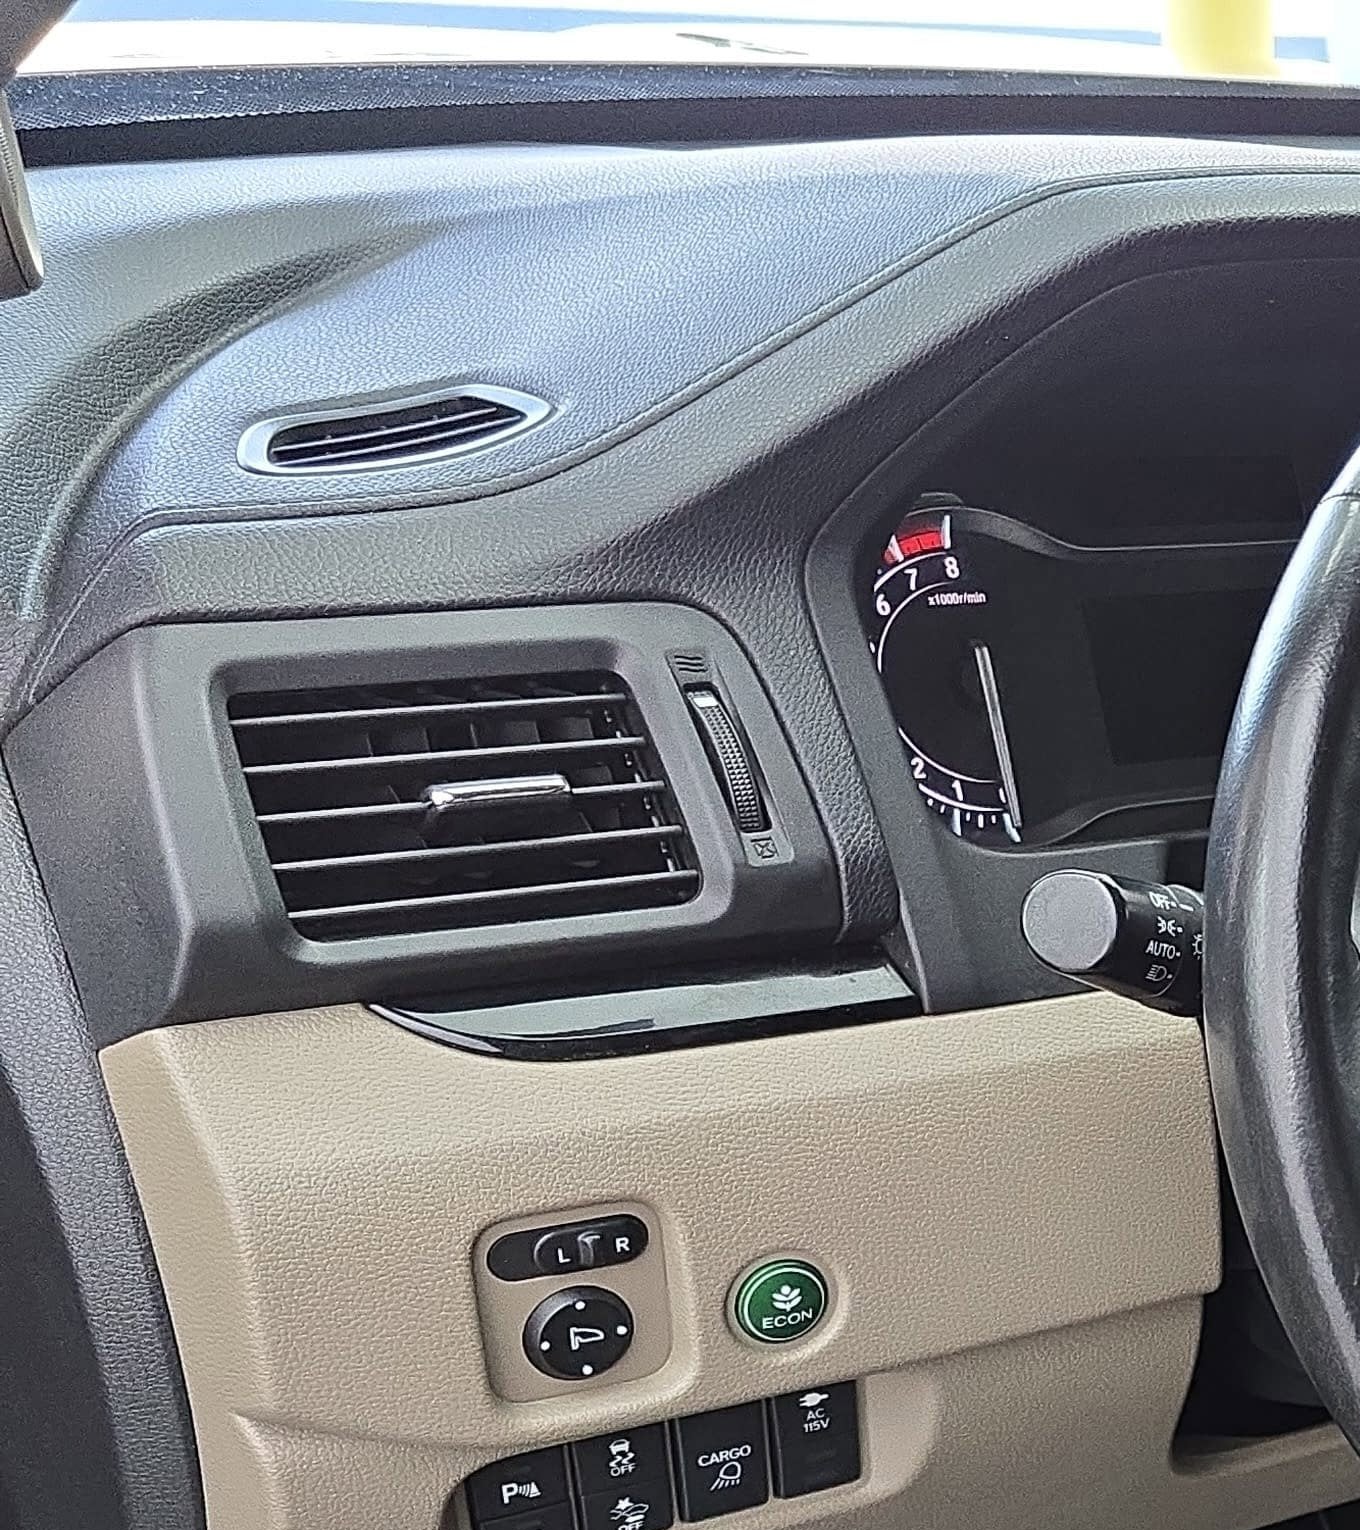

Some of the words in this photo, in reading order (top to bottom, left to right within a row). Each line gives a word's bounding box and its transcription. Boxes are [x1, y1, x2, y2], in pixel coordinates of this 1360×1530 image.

[944, 556, 960, 579] 8
[904, 568, 918, 591] 7
[876, 593, 891, 617] 6
[927, 592, 987, 607] x1000r/min
[911, 756, 926, 780] 2
[951, 779, 964, 802] 1
[1145, 939, 1176, 960] AUTO
[614, 1236, 631, 1253] R
[557, 1247, 571, 1264] L
[762, 1308, 813, 1330] ECON
[806, 1408, 825, 1421] AC
[803, 1418, 831, 1433] 115V
[697, 1444, 752, 1467] CARGO
[610, 1463, 637, 1477] OFF
